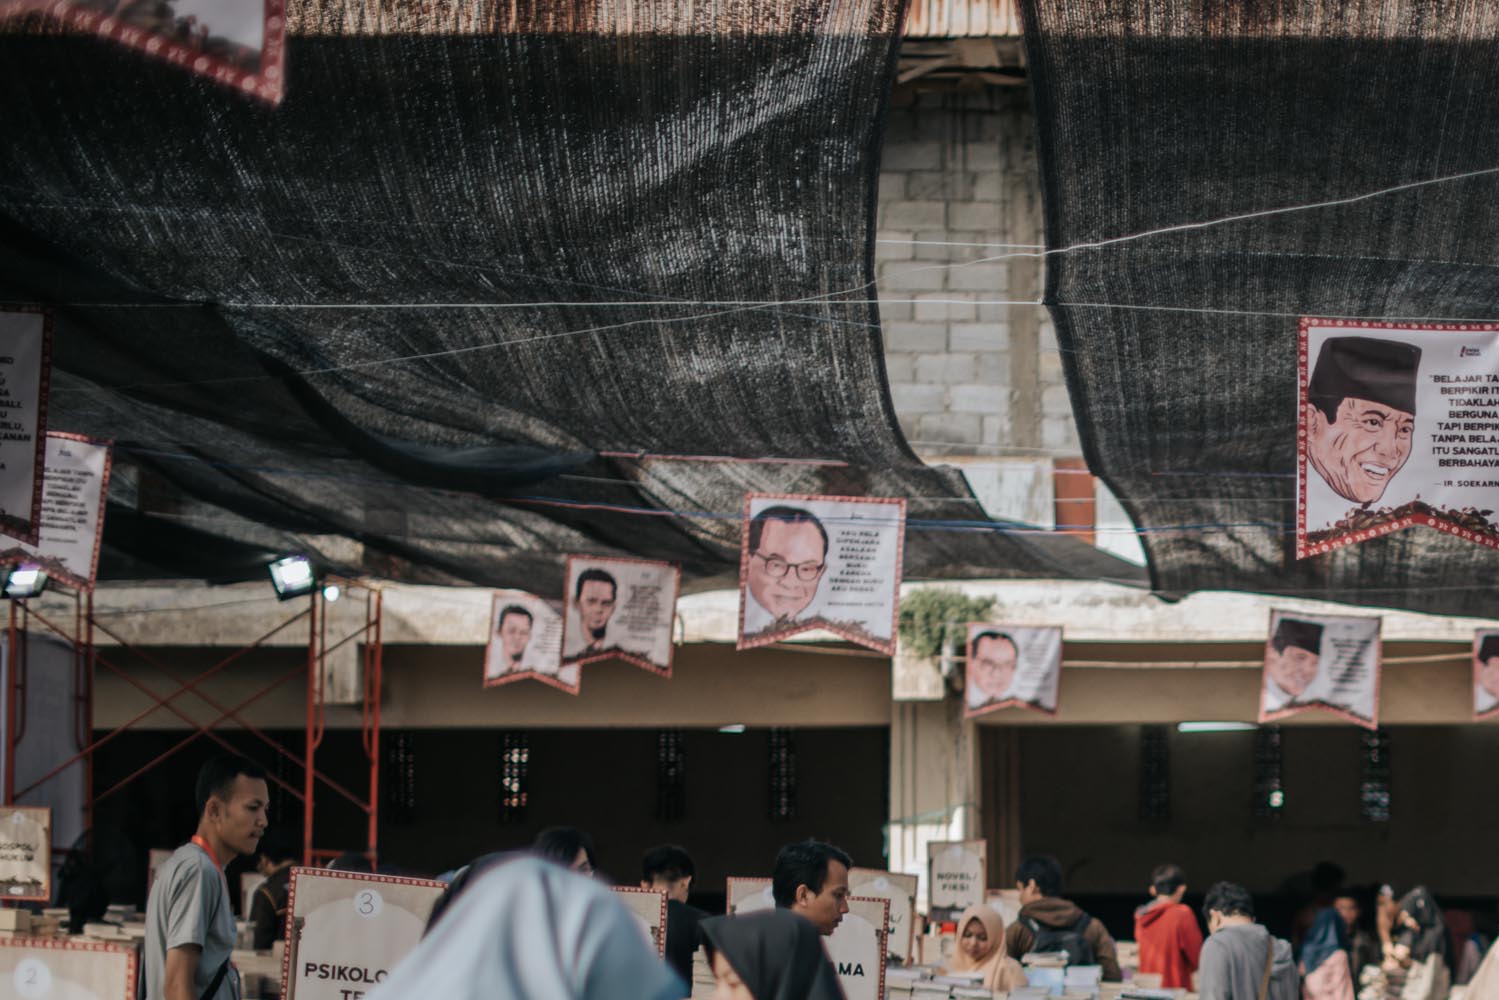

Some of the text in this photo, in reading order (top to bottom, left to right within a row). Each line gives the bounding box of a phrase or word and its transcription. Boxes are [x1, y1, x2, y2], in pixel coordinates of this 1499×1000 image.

[1440, 386, 1489, 395] BERPIKIR
[1437, 422, 1461, 431] TAPI
[1431, 434, 1466, 443] TANPA
[1432, 446, 1450, 455] ITU
[359, 892, 374, 914] 3
[25, 968, 37, 985] 2
